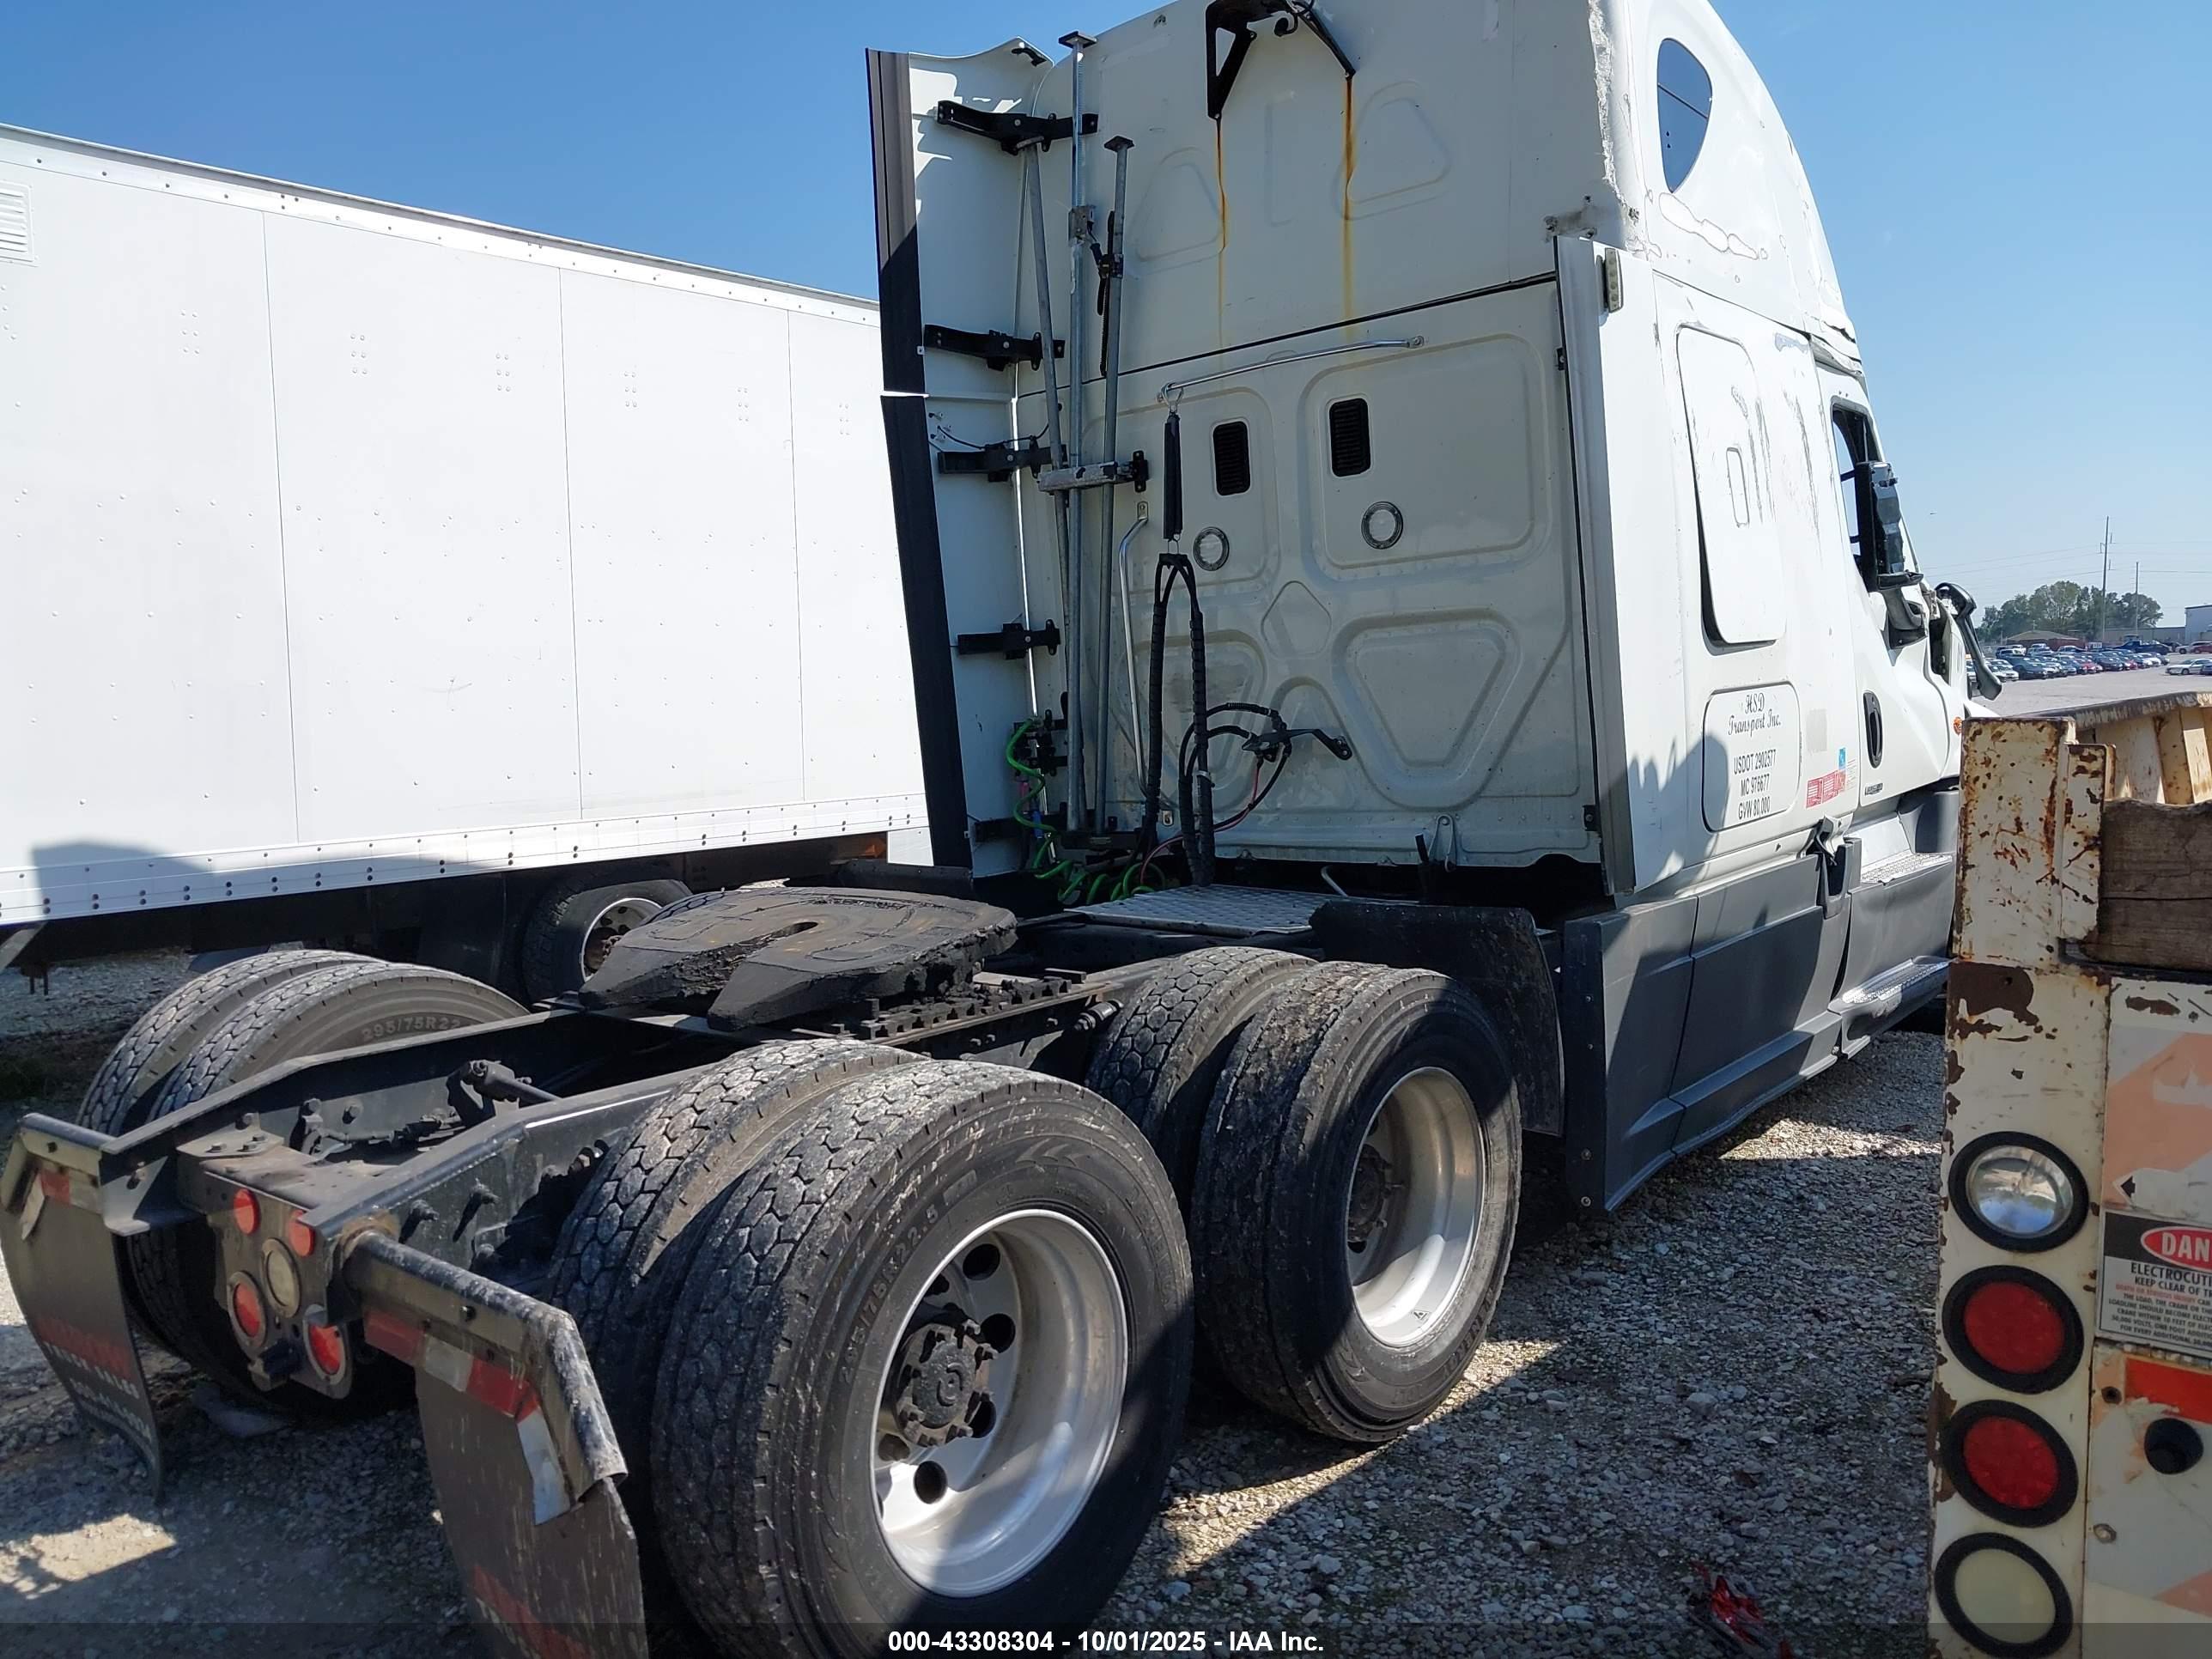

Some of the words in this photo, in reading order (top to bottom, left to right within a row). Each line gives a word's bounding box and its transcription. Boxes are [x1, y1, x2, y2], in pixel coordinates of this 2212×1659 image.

[1745, 692, 1765, 714] HSD
[1728, 713, 1765, 738] Transport
[1767, 708, 1781, 728] Inc.
[1734, 753, 1753, 775] USDOT
[1741, 777, 1749, 797] MC
[1738, 800, 1753, 819] GVW
[1753, 796, 1771, 817] 80,000
[2162, 1232, 2210, 1262] DAN
[2131, 1262, 2212, 1287] ELECTROCUTI
[2135, 1276, 2156, 1287] KEEP
[2158, 1281, 2185, 1293] CLEAR
[2189, 1286, 2199, 1296] OF
